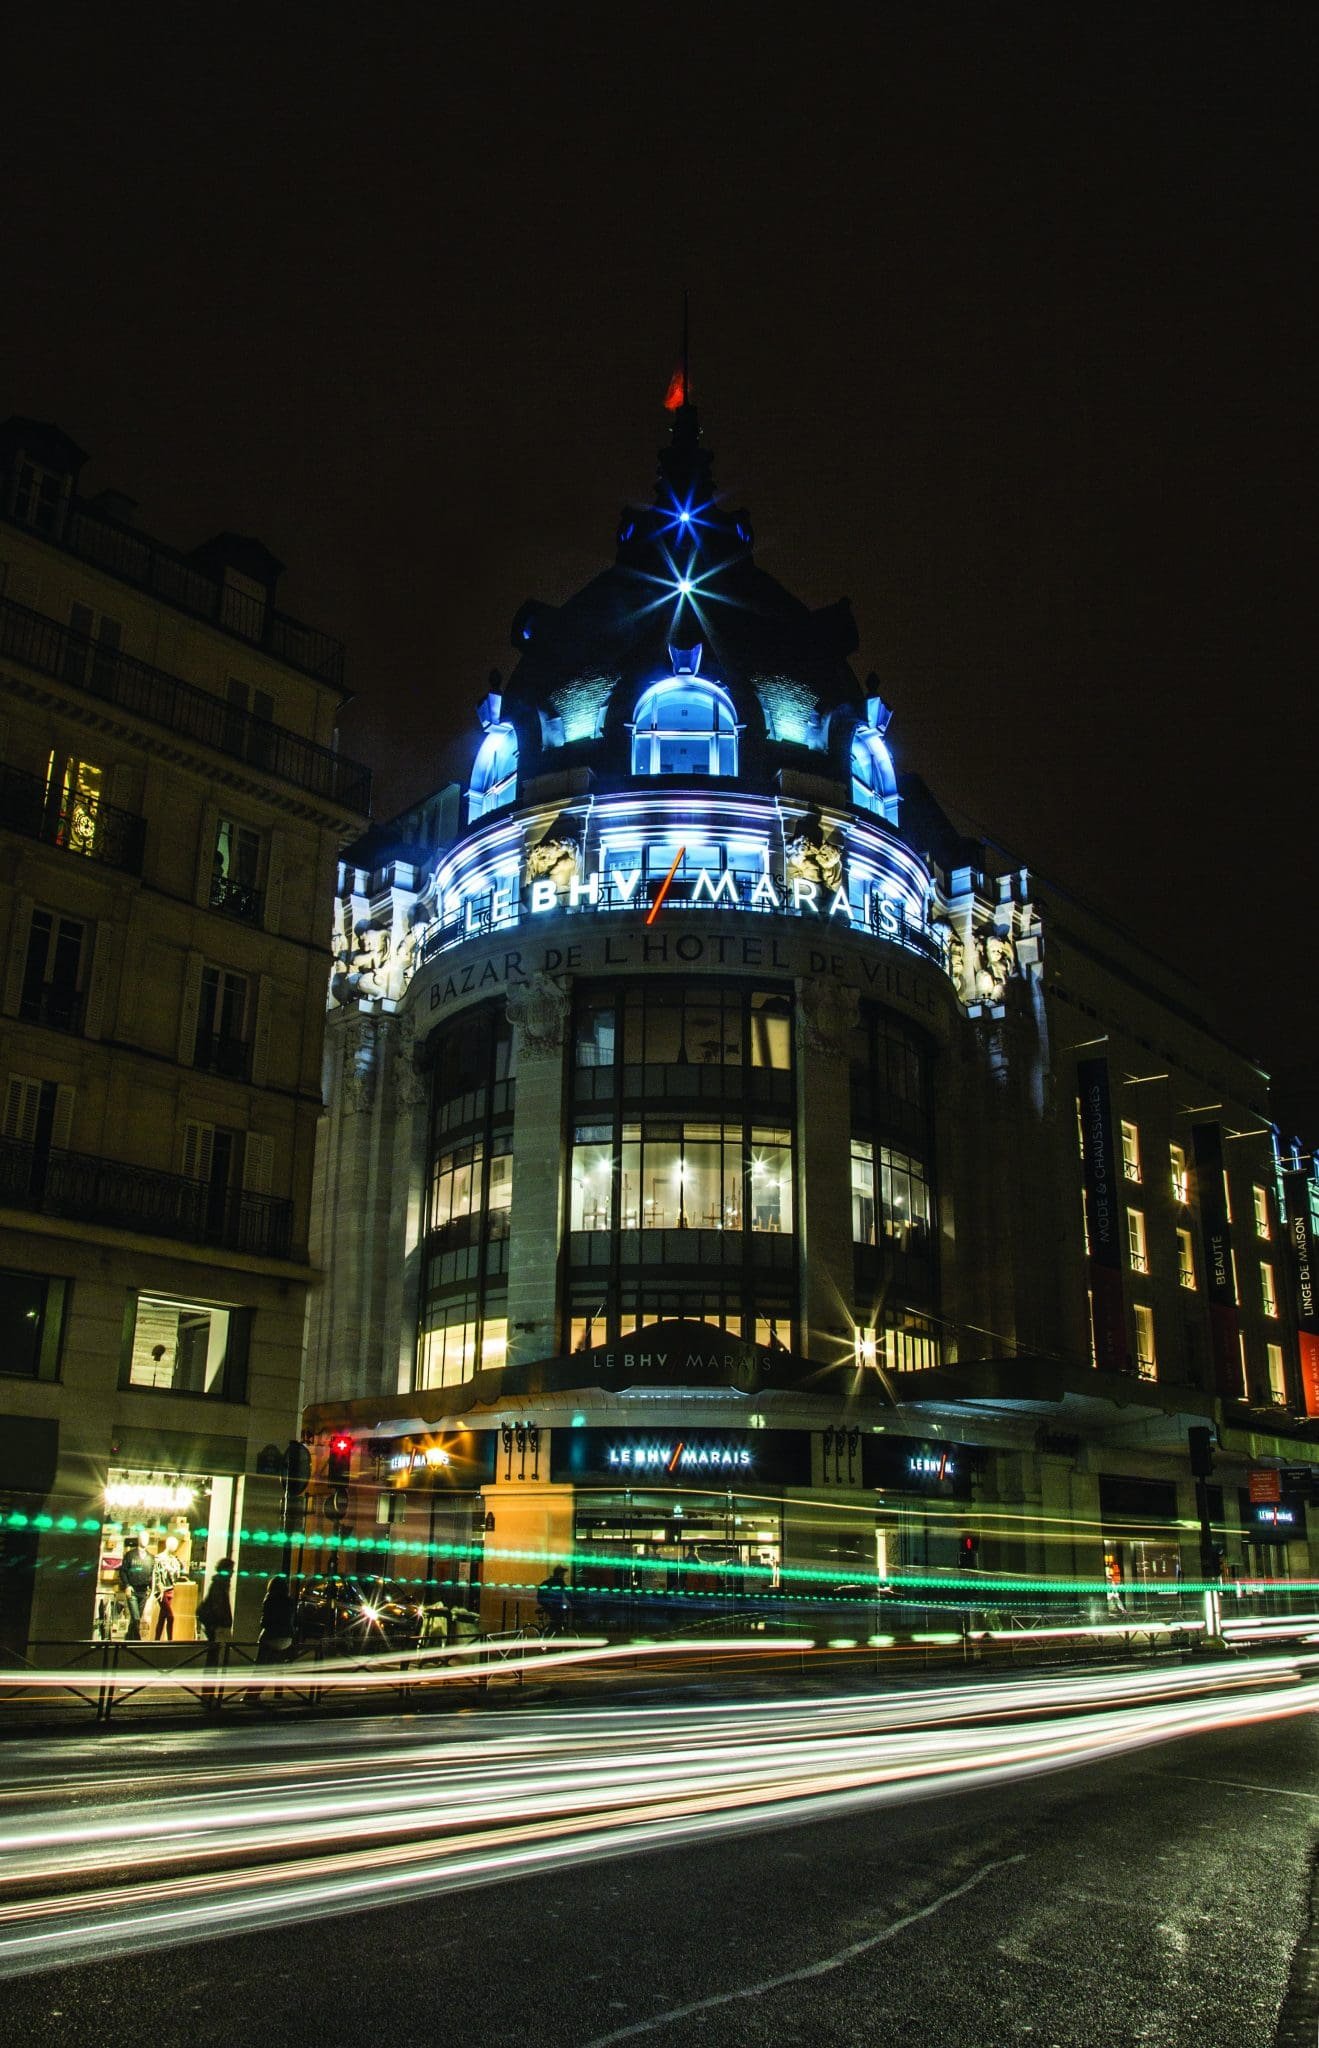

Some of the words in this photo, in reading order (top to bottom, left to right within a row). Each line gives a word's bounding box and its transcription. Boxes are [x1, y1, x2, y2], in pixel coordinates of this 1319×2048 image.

[464, 889, 512, 934] LE
[531, 869, 642, 914] BHV
[692, 868, 898, 933] MARAIS
[430, 951, 526, 1010] BAZAR
[545, 945, 582, 972] DE
[810, 951, 845, 977] DE
[860, 957, 937, 1015] VILLE
[1088, 1085, 1106, 1180] CHAUSSURES
[1096, 1197, 1110, 1242] MODE
[1295, 1217, 1307, 1262] MAISON
[1299, 1264, 1310, 1281] DE
[1301, 1282, 1313, 1317] LINGE
[593, 1354, 616, 1368] LE
[624, 1354, 668, 1368] BHV
[686, 1354, 772, 1371] MARAIS
[610, 1450, 630, 1463] LE
[634, 1450, 672, 1463] BHV
[681, 1449, 751, 1464] MARAIS
[910, 1458, 923, 1470] LE
